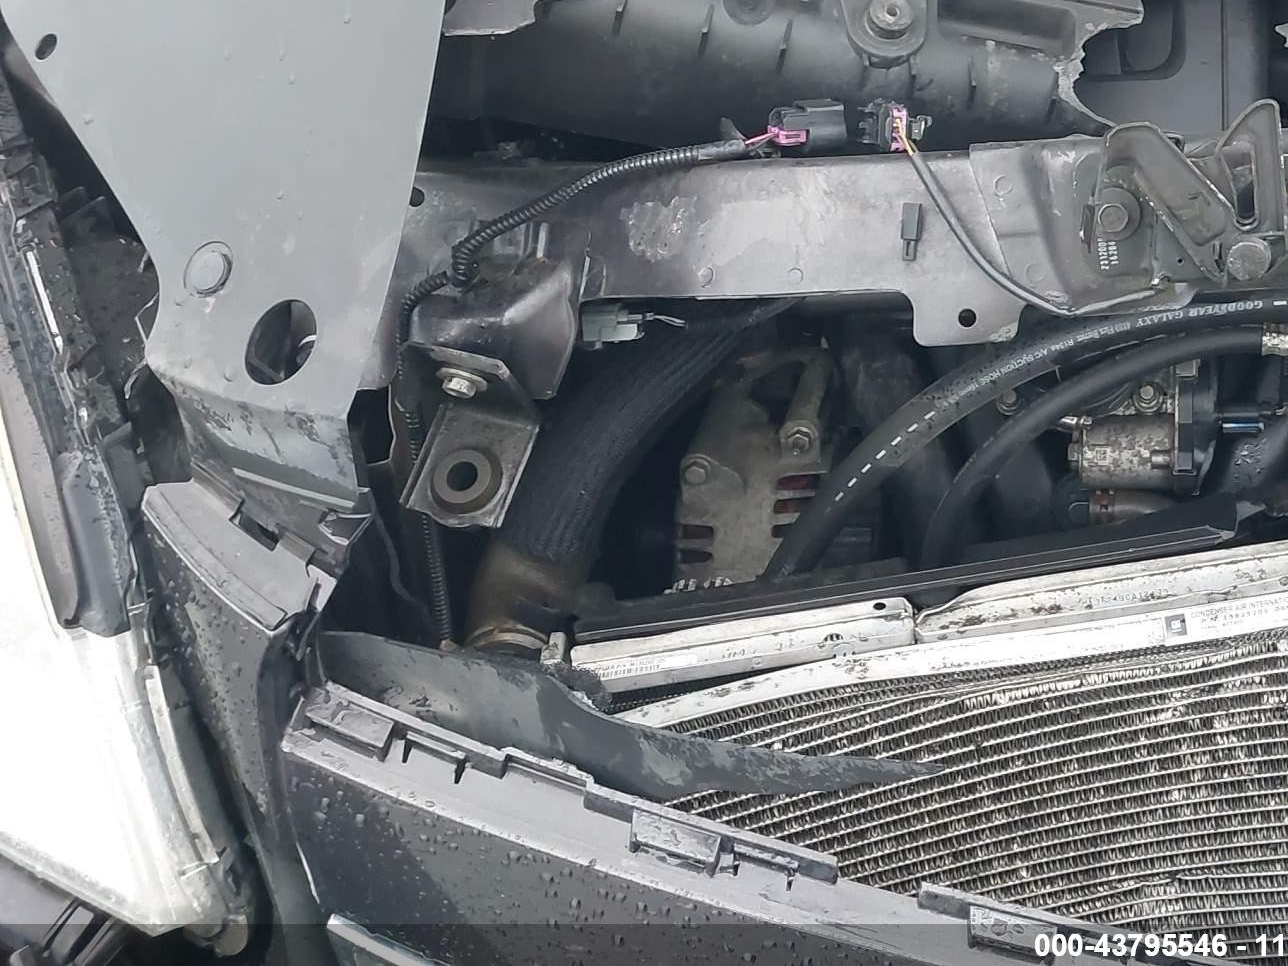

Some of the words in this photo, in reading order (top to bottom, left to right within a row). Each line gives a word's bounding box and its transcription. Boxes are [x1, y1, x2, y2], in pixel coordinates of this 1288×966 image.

[1188, 299, 1263, 318] GOODYEAR
[1135, 310, 1184, 328] GALAXY
[1001, 353, 1034, 376] SUCTION
[978, 368, 1001, 385] HOSE
